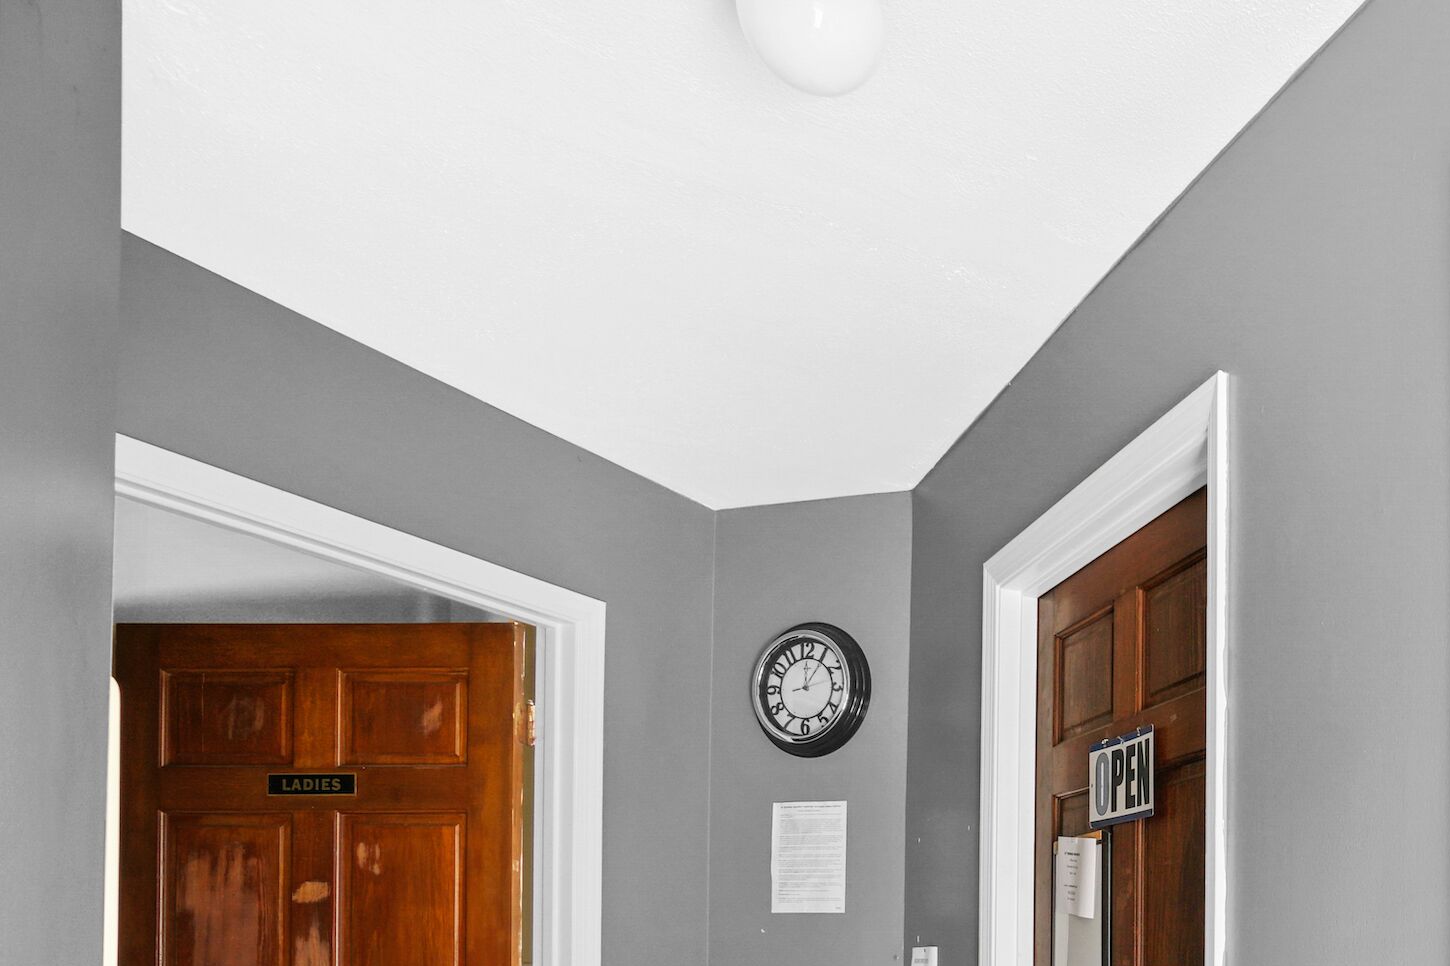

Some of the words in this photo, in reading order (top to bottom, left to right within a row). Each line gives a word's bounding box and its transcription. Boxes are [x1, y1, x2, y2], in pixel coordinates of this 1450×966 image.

[800, 642, 815, 659] 12
[820, 647, 828, 662] 1
[772, 662, 786, 678] 10
[828, 660, 842, 674] 2
[767, 685, 781, 695] 9
[832, 682, 844, 692] 3
[771, 702, 784, 715] 8
[801, 719, 810, 735] 6
[1095, 738, 1150, 816] OPEN
[282, 778, 341, 791] LADIES
